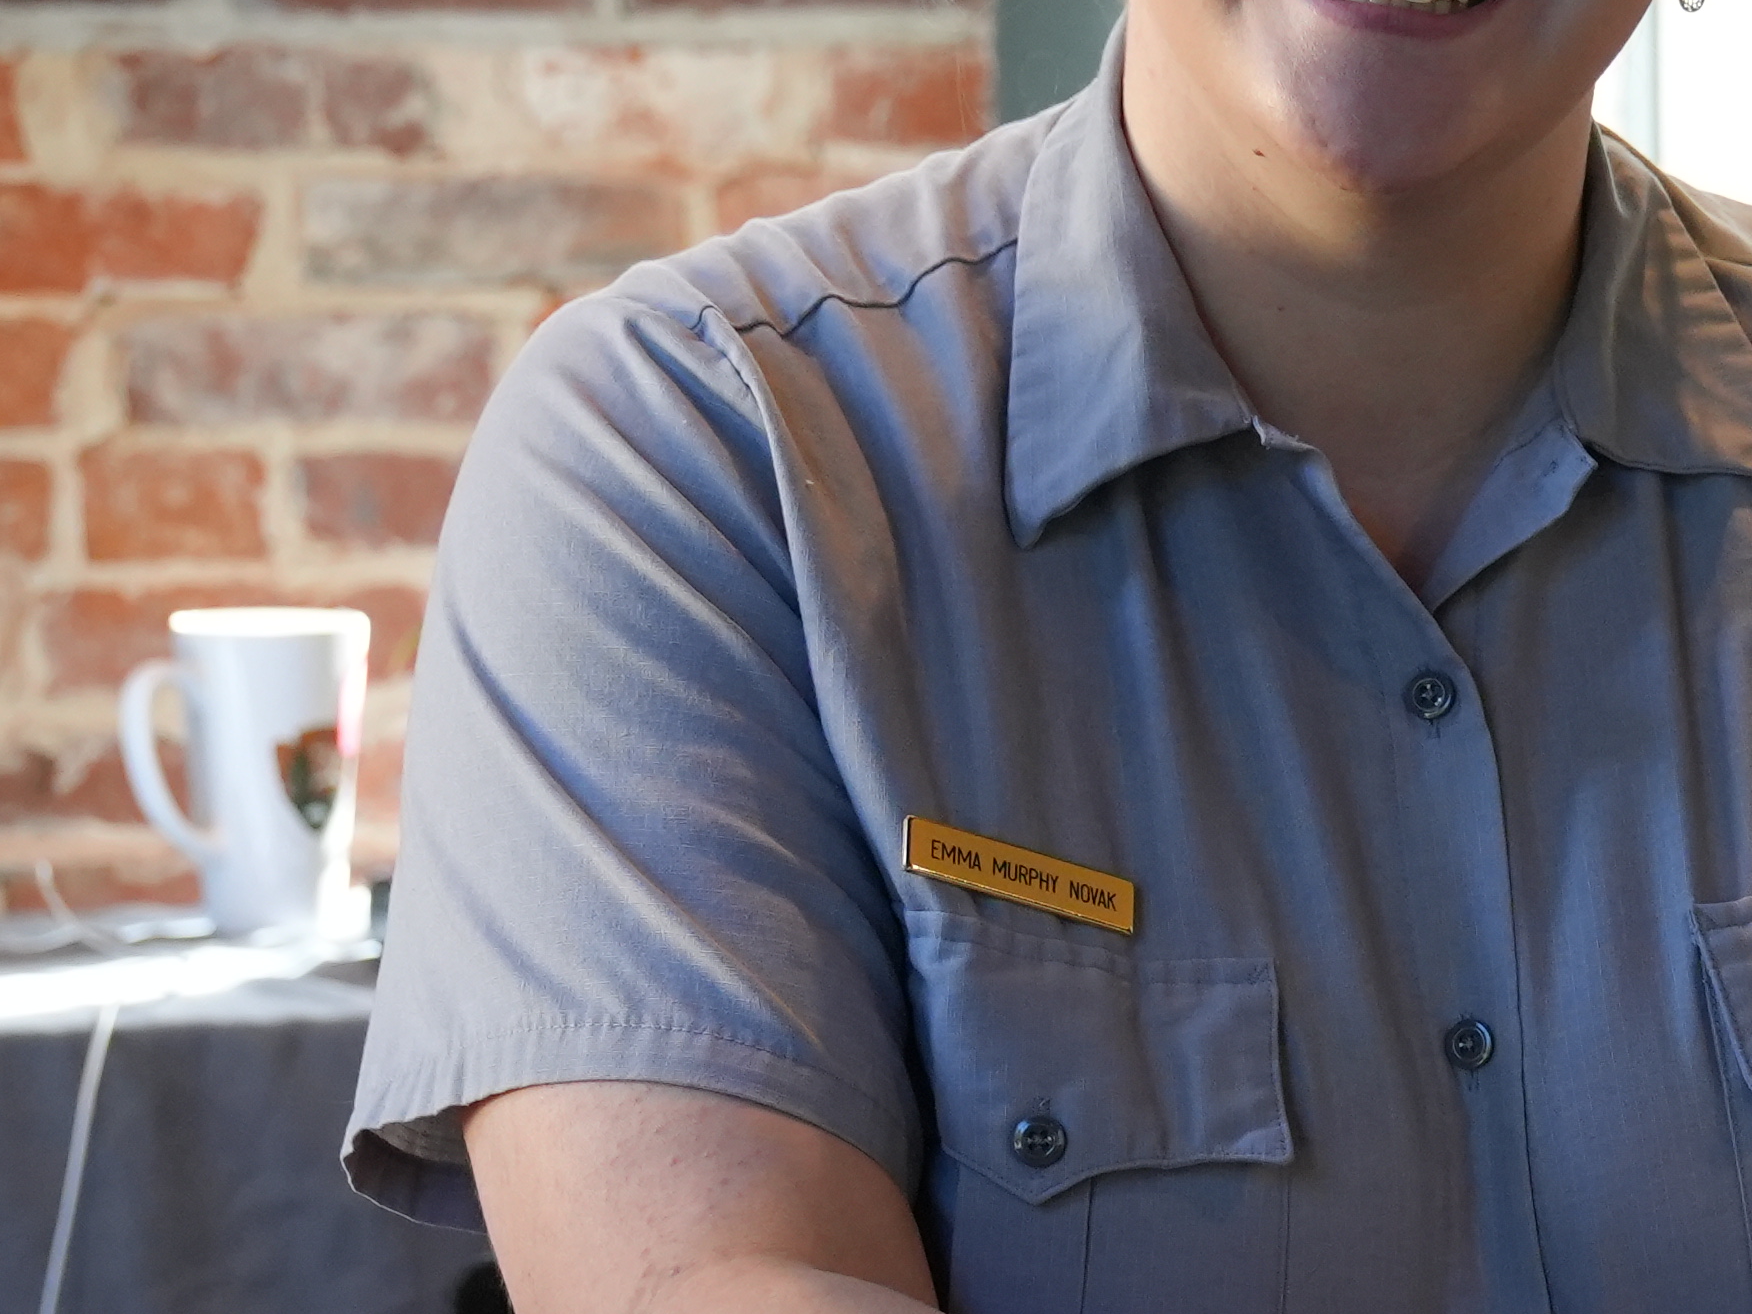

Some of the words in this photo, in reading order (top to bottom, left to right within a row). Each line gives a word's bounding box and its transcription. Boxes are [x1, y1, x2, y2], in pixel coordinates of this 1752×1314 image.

[931, 838, 982, 872] EMMA
[992, 857, 1059, 894] MURPHY
[1069, 879, 1118, 912] NOVAK
